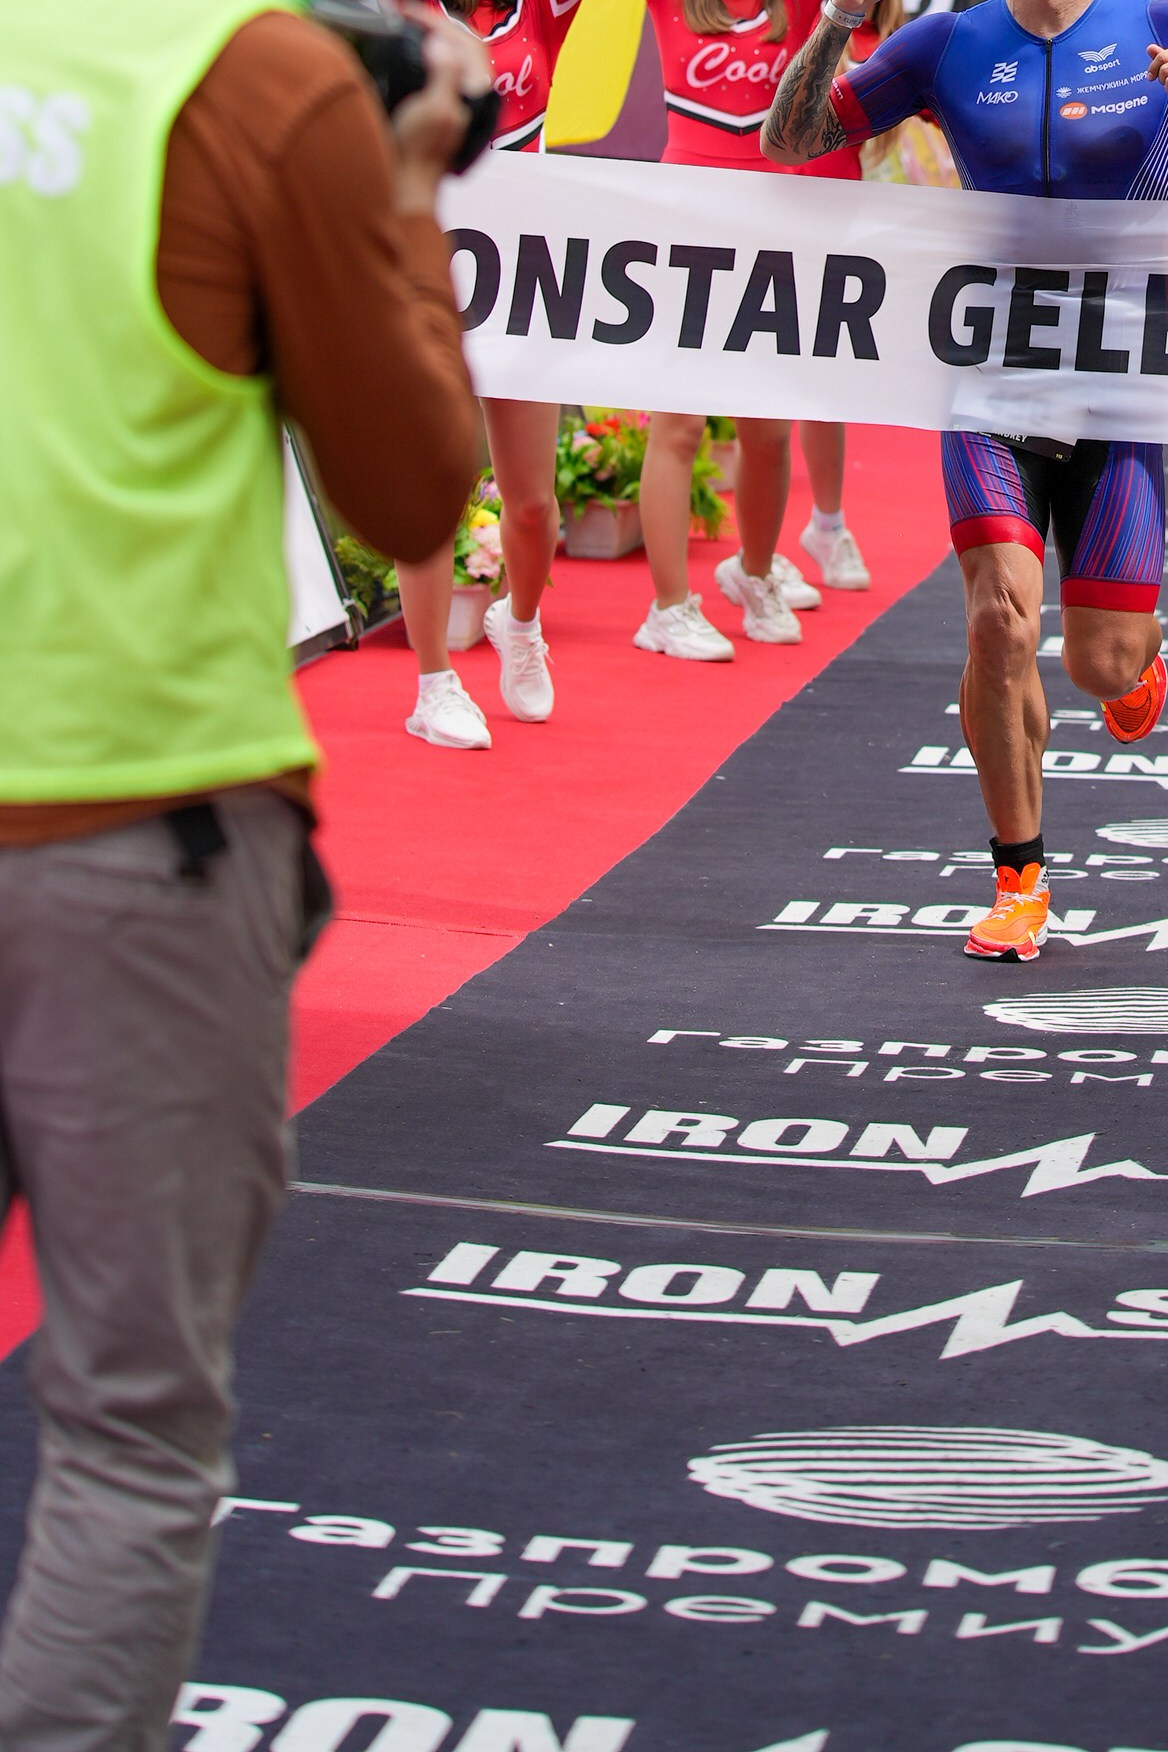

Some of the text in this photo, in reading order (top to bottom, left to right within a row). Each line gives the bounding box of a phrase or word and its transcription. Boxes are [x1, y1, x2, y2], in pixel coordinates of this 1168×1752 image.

[686, 42, 788, 88] Cool
[1076, 78, 1129, 94] ЖЕМЧУЖИНА
[976, 90, 1019, 105] MAKO
[1091, 95, 1148, 115] Magene
[443, 228, 886, 361] ONSTAR
[566, 1103, 970, 1160] IRON
[426, 1241, 881, 1314] IRON
[170, 1682, 636, 1752] RON
